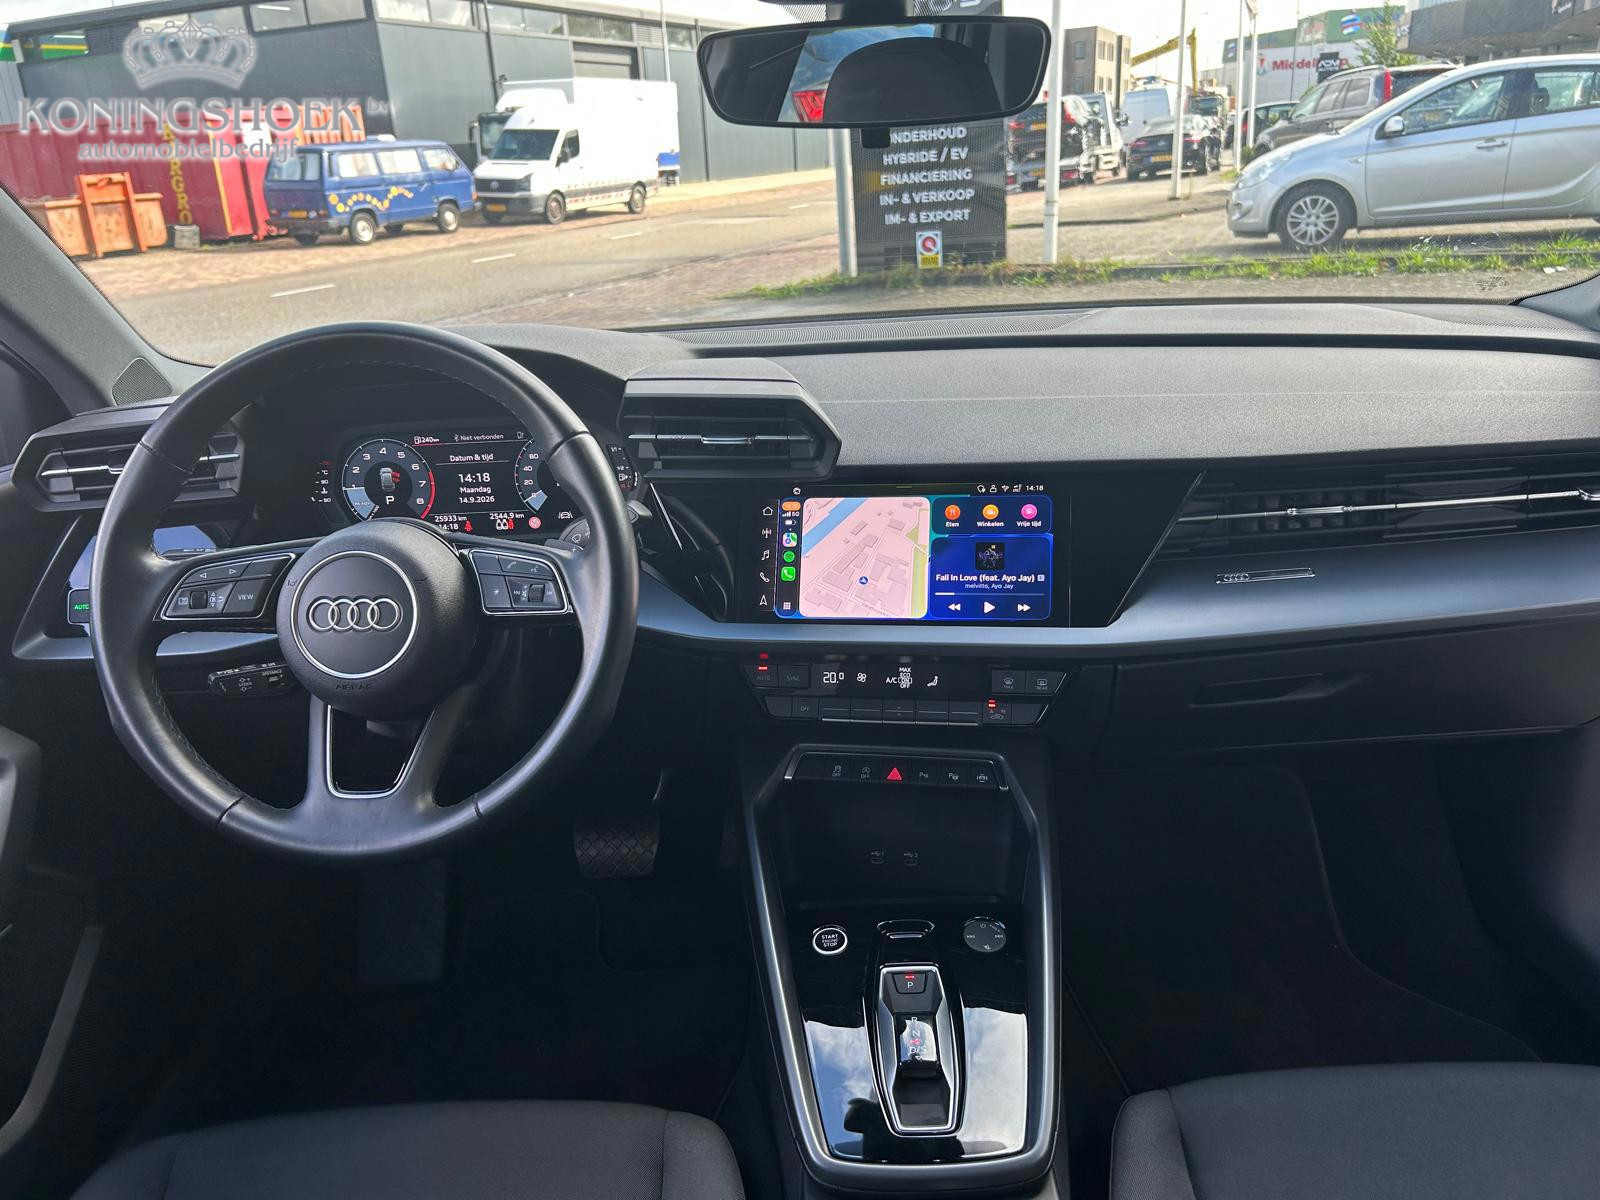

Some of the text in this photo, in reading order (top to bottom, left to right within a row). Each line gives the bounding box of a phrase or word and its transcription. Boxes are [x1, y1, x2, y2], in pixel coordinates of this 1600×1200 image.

[889, 126, 968, 144] NDERHOUD
[882, 150, 938, 166] HYBRIDE
[950, 147, 969, 161] EV
[879, 168, 973, 186] FINANCIERING
[901, 192, 911, 205] &
[912, 188, 976, 204] VERKOOP
[907, 211, 918, 224] &
[919, 208, 971, 223] EXPORT
[474, 433, 504, 441] verbonden
[379, 447, 387, 455] 4
[397, 451, 405, 459] 5
[362, 453, 371, 461] 3
[449, 454, 473, 462] Datum
[481, 453, 494, 462] tijd
[352, 466, 360, 474] 2
[411, 463, 420, 471] 6
[458, 472, 491, 484] 14:18
[418, 480, 427, 488] 7
[460, 486, 492, 495] Maandag
[386, 495, 395, 505] P
[459, 495, 495, 504] 14.9.2026
[434, 515, 458, 523] 25933
[1016, 520, 1042, 528] Vrije tijd
[935, 574, 950, 582] Fall
[959, 574, 978, 582] Love
[979, 573, 1000, 583] (feat.
[1001, 574, 1017, 583] Ayo
[1017, 573, 1035, 583] Jay)
[237, 593, 254, 601] VIEW
[885, 676, 898, 684] A/C
[907, 981, 914, 989] P
